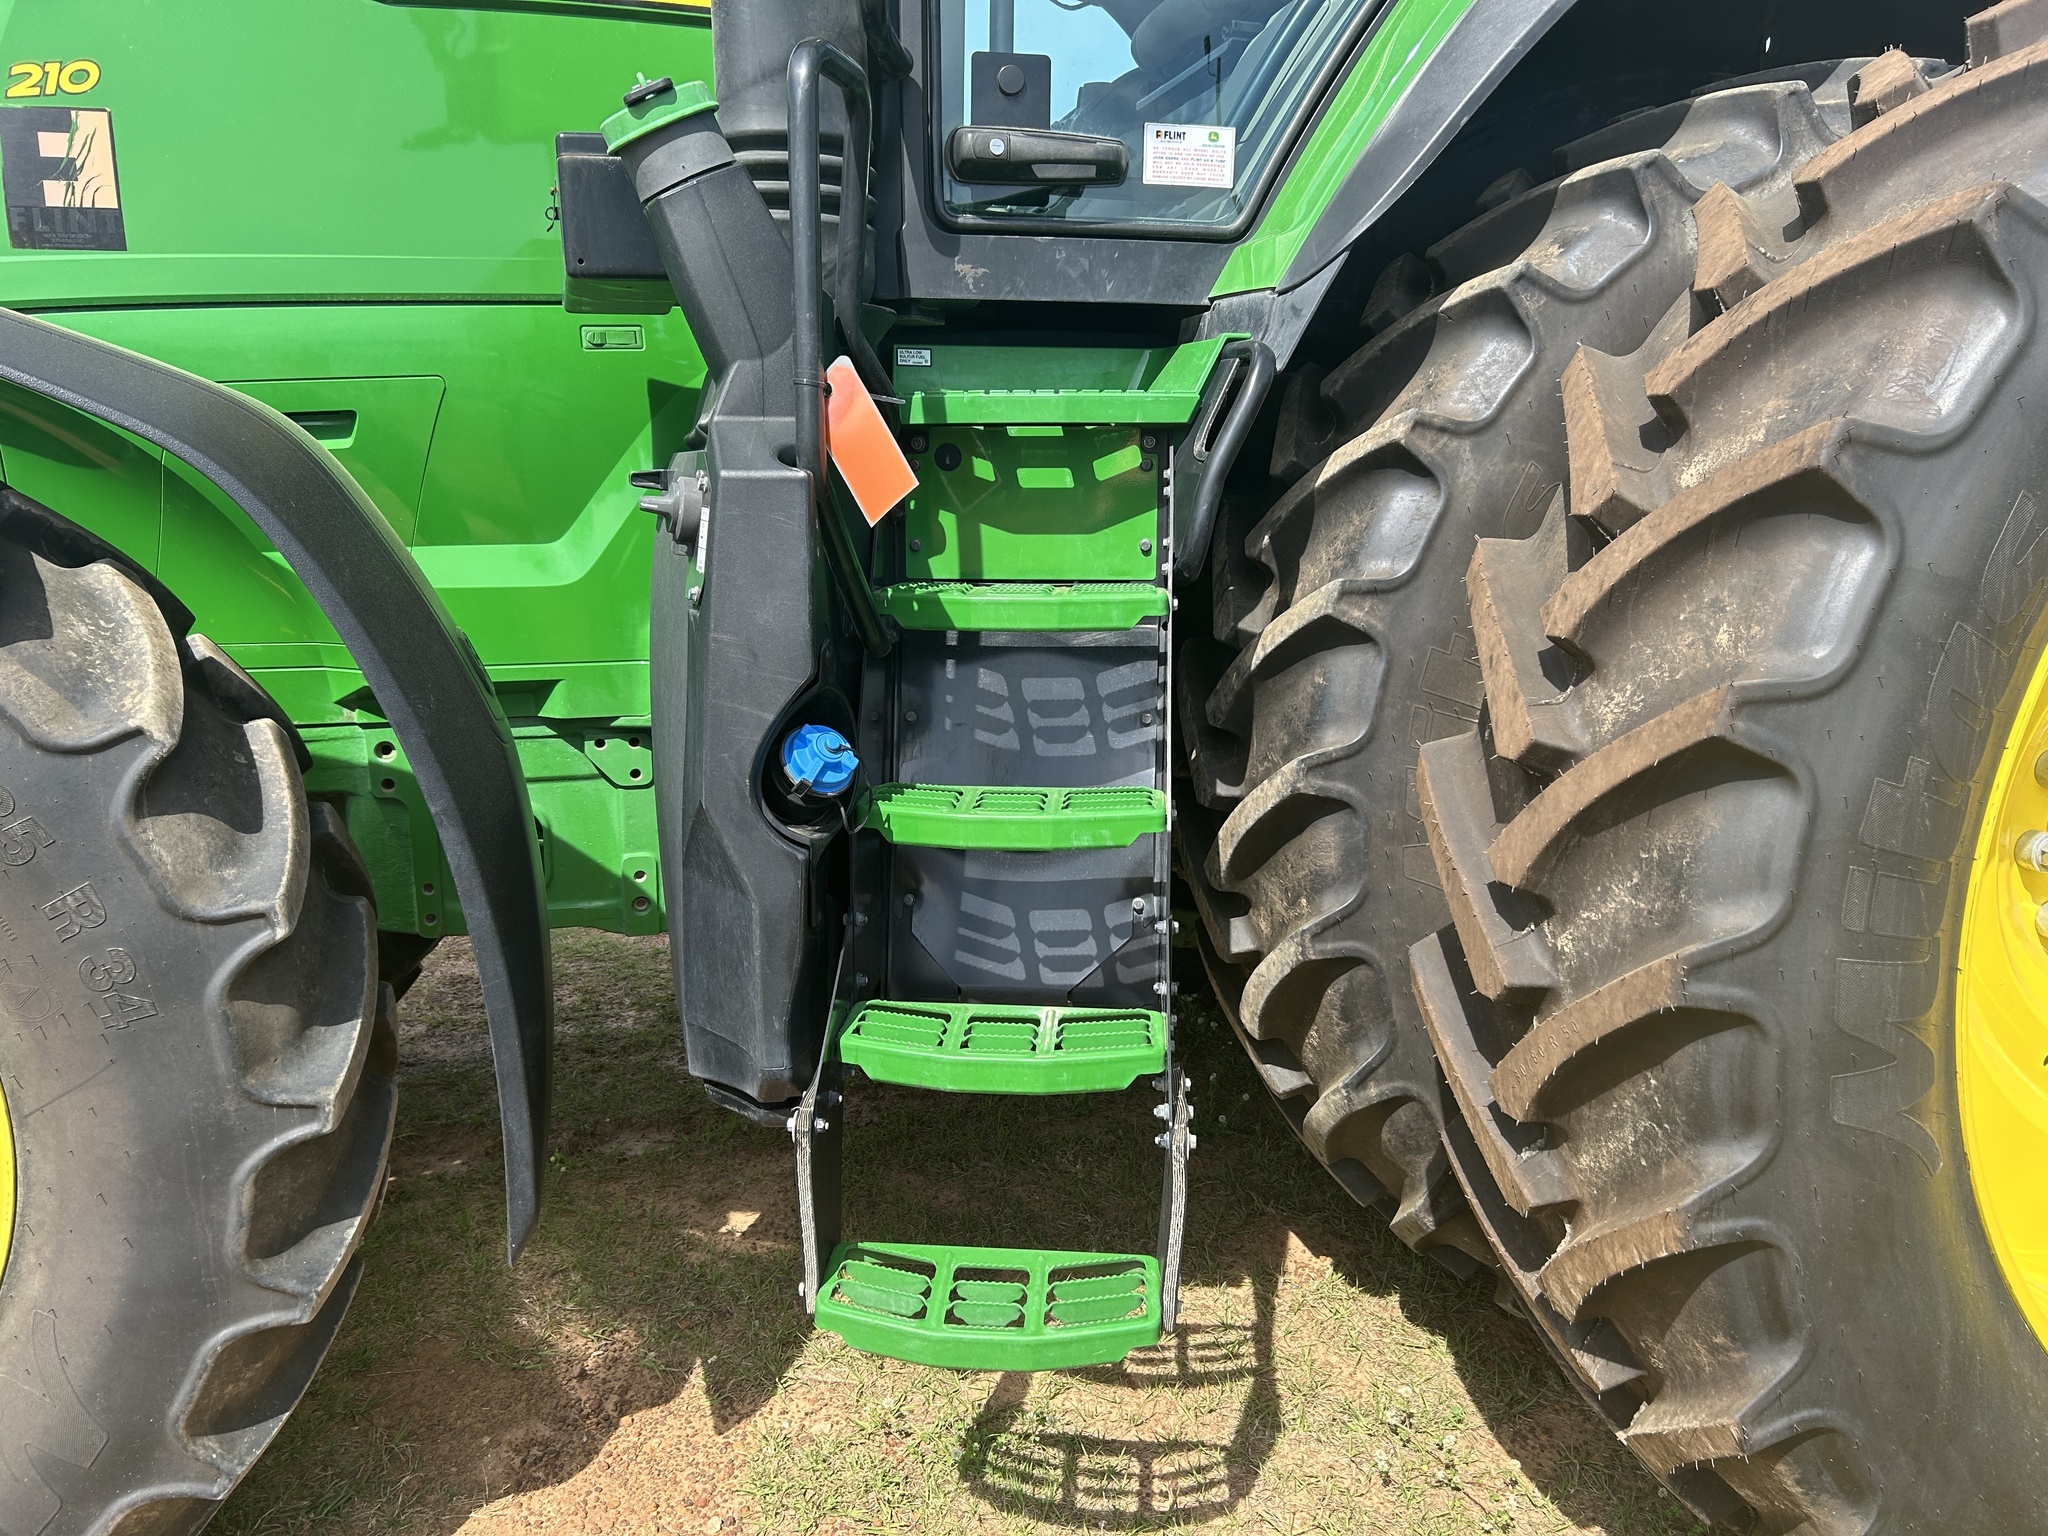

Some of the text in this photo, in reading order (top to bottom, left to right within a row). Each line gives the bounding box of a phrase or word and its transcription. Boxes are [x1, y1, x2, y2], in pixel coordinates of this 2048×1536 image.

[5, 59, 101, 98] 210
[1164, 131, 1186, 140] FLINT
[9, 207, 119, 234] FLINT
[41, 881, 107, 943] R
[78, 947, 158, 1030] 34
[1547, 1034, 1560, 1050] R
[1561, 1020, 1580, 1040] 50
